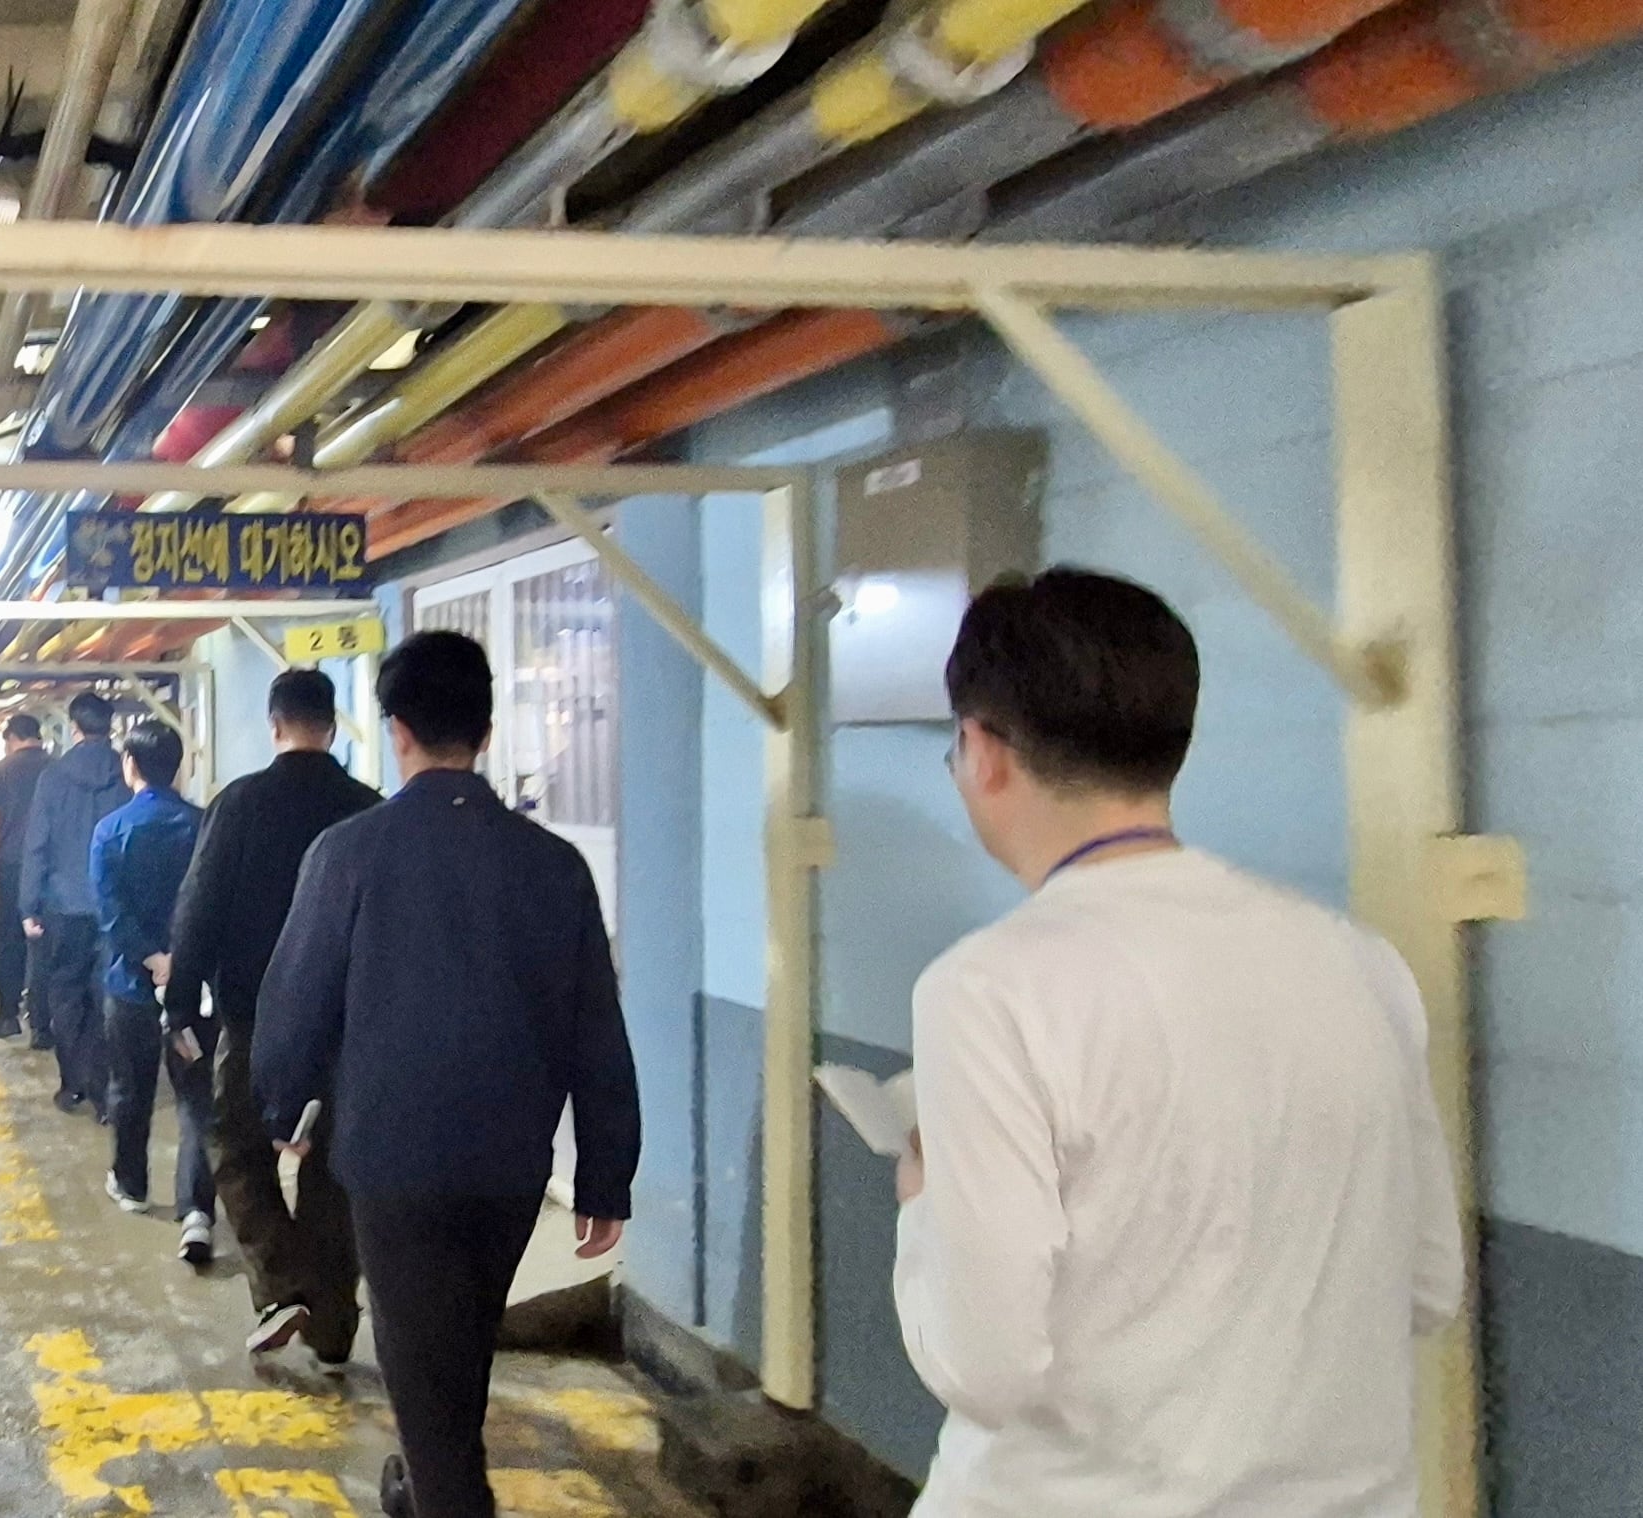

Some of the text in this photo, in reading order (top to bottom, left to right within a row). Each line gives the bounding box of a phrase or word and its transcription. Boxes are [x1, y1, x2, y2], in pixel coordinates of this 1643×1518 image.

[129, 516, 229, 584] 정지선에
[238, 517, 364, 585] 대기하시오
[309, 630, 324, 652] 2
